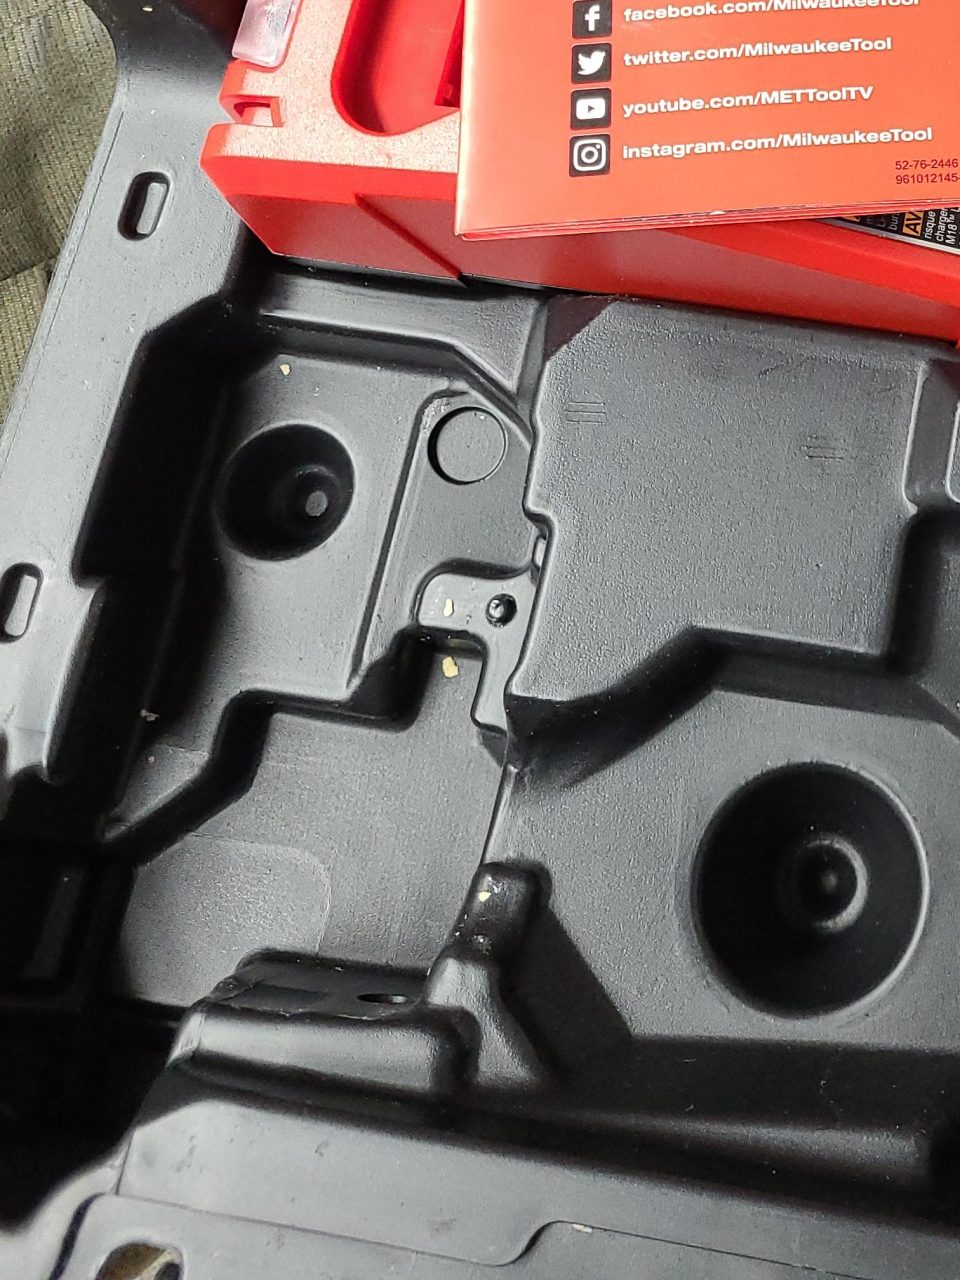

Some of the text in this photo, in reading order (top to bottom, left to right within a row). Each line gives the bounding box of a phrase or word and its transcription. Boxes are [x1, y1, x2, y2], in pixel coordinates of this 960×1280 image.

[624, 37, 893, 67] twitter.com/MilwaukeeTool
[622, 86, 874, 117] youtube.com/METToolTV
[622, 127, 934, 161] instagram.com/MilwaukeeTool
[894, 158, 960, 171] 52-76-2446
[924, 211, 936, 239] risque
